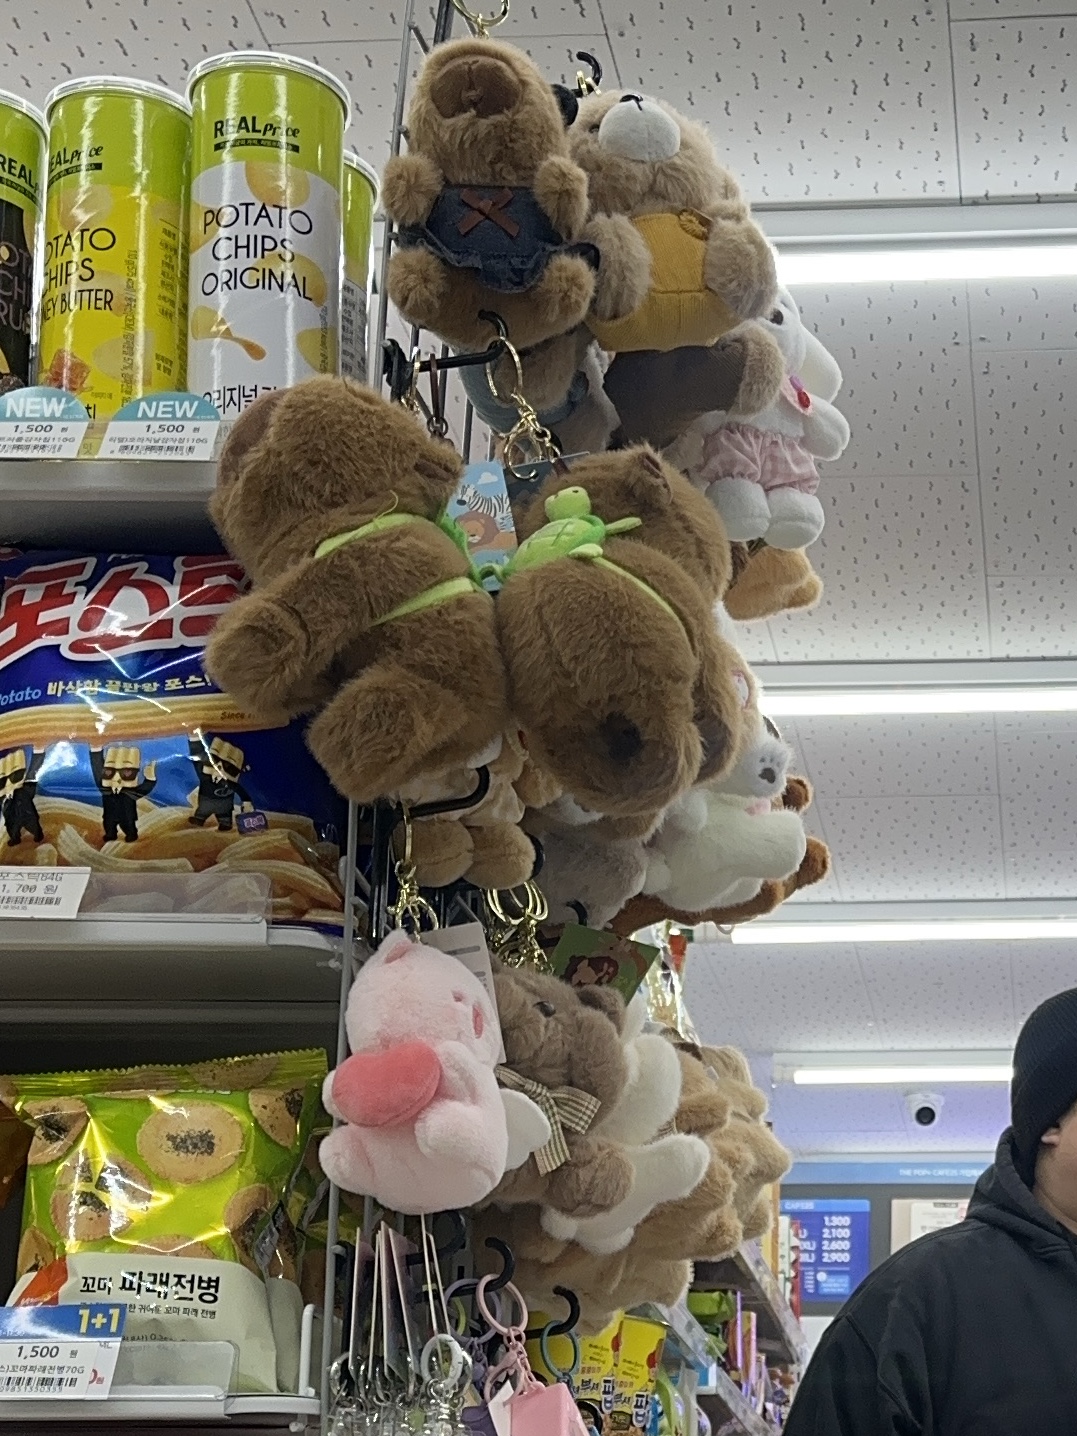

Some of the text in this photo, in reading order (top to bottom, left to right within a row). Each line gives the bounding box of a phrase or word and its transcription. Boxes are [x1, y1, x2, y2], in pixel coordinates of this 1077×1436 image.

[203, 202, 313, 235] POTATO
[212, 234, 295, 263] CHIPS
[202, 266, 313, 301] ORIGINAL
[5, 397, 66, 418] NEW
[137, 400, 198, 418] NEW
[13, 424, 53, 434] 1,500
[145, 424, 185, 434] 1,500
[1, 884, 37, 894] 1,700
[80, 1270, 220, 1304] 꼬마 파래전병
[79, 1308, 120, 1334] 1+1
[17, 1345, 59, 1358] 1,500
